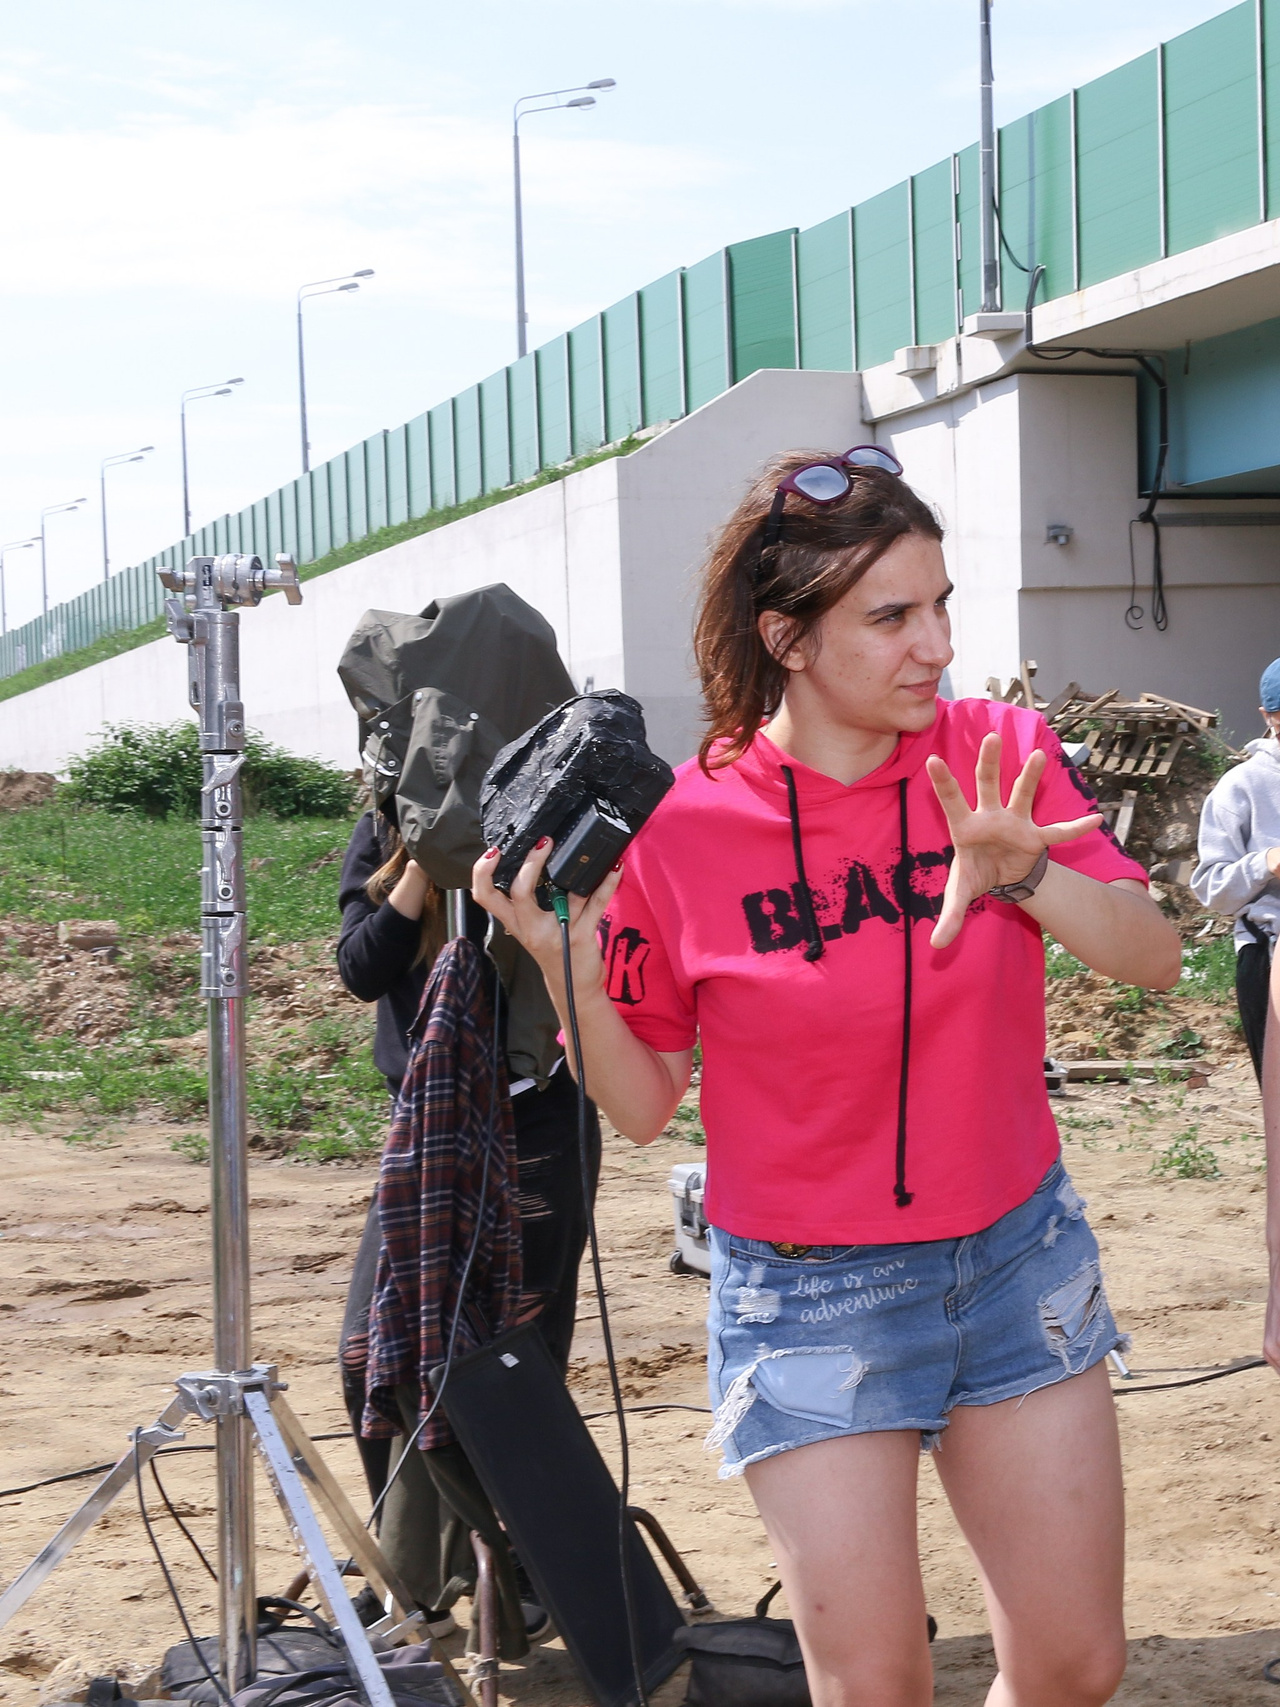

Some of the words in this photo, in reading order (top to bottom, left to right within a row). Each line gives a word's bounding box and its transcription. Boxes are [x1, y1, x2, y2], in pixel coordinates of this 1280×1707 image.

[742, 846, 984, 954] BLAC
[789, 1274, 835, 1300] Life
[842, 1271, 864, 1289] is
[873, 1259, 906, 1278] an
[800, 1278, 919, 1324] adventure
